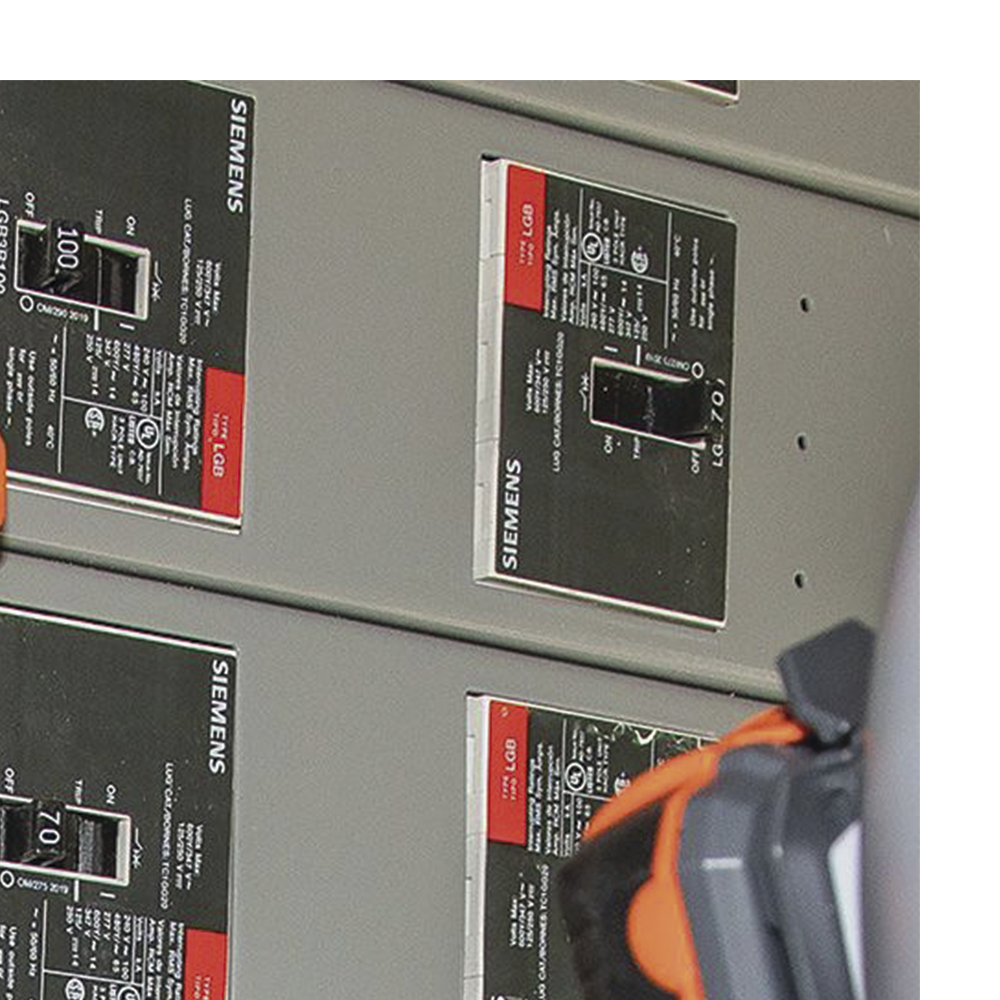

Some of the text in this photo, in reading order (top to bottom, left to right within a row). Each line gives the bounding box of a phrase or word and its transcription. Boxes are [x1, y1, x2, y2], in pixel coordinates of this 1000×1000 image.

[228, 99, 248, 215] SIEMENS
[24, 191, 35, 219] OFF
[521, 202, 534, 238] LGB
[125, 215, 137, 237] ON
[56, 225, 81, 272] 100
[710, 389, 725, 424] 70
[212, 441, 226, 478] LGB
[603, 434, 613, 455] ON
[691, 449, 700, 474] OFF
[501, 458, 520, 571] SIEMENS
[209, 659, 229, 775] SIEMENS
[504, 737, 517, 772] LGB
[4, 767, 15, 794] OFF
[106, 784, 117, 805] ON
[38, 807, 62, 847] 70
